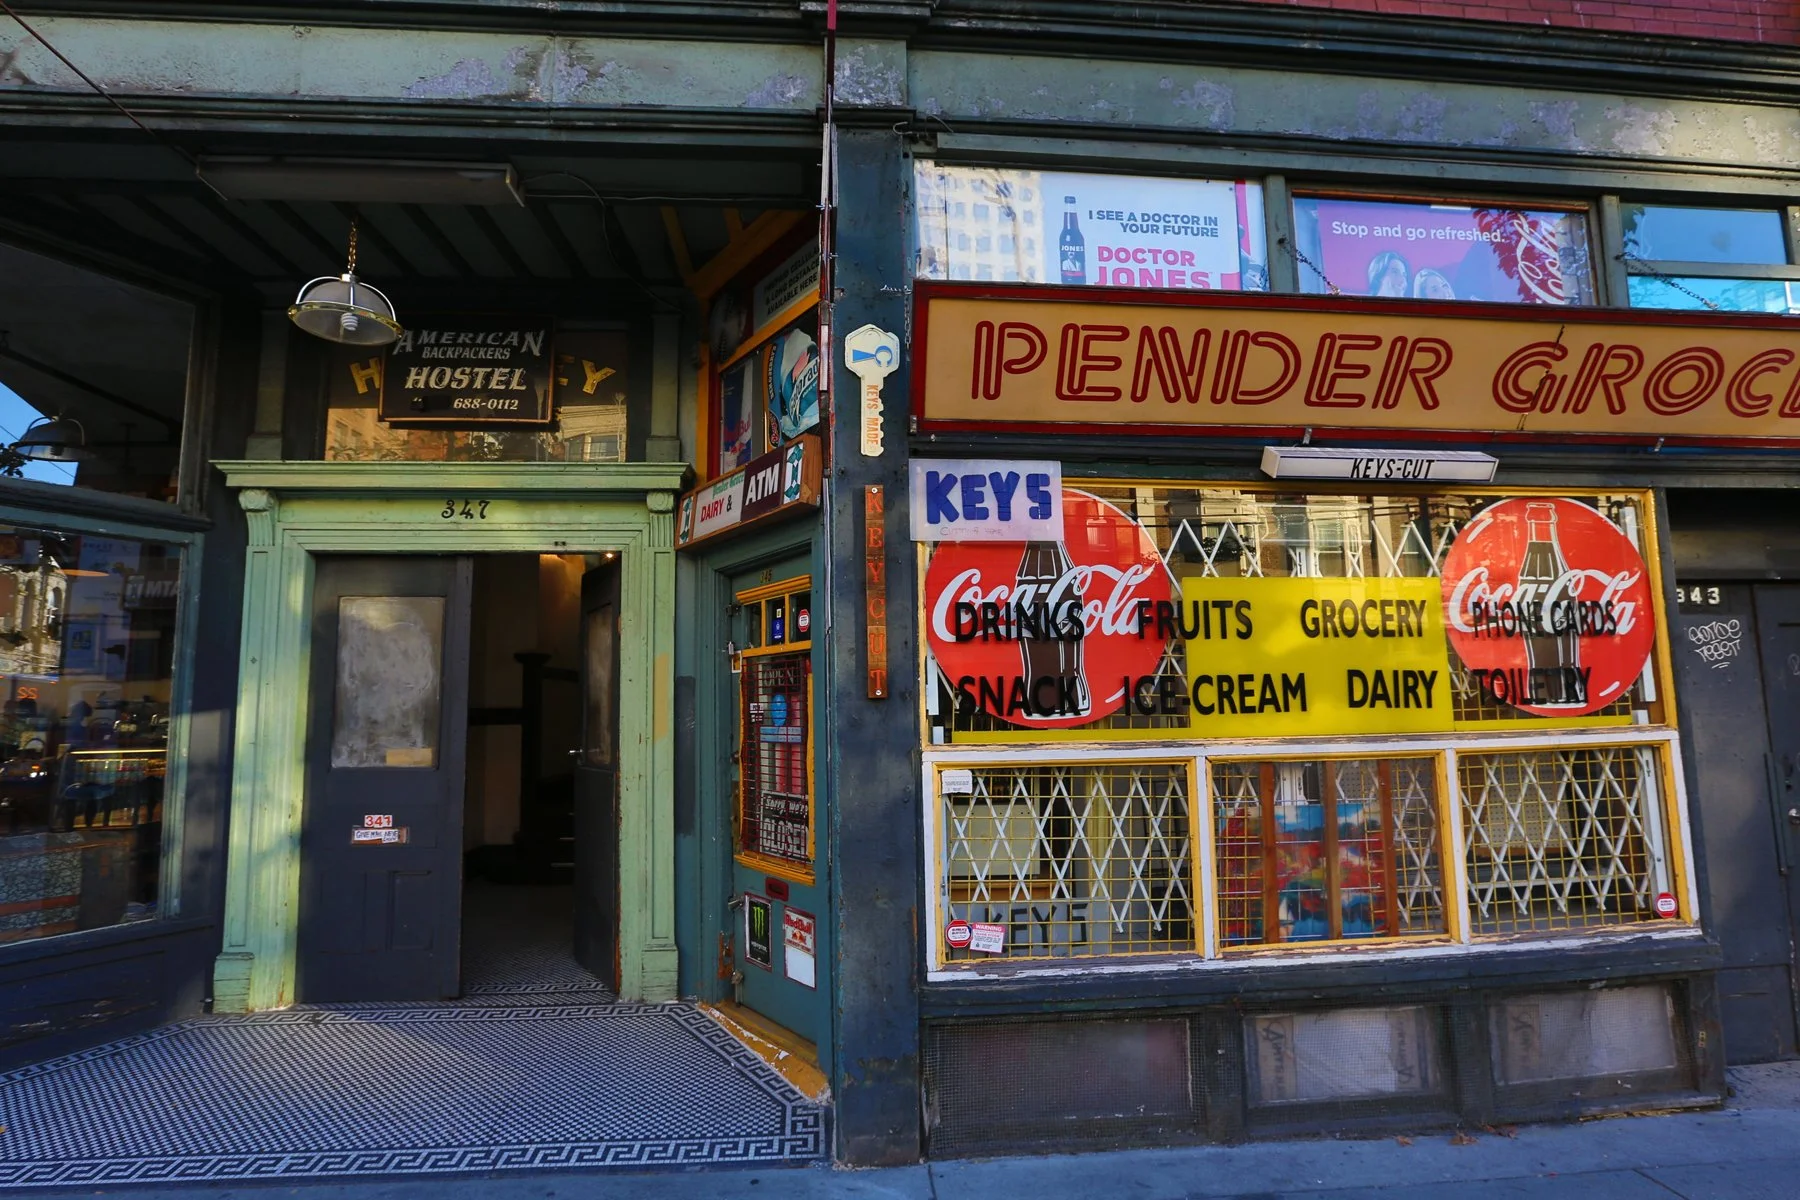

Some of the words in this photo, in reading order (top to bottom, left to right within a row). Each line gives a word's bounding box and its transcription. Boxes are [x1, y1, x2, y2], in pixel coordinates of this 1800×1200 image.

[1088, 210, 1093, 220] I
[1096, 210, 1124, 221] SEE
[1127, 212, 1138, 223] A
[1140, 213, 1201, 226] DOCTOR
[1203, 216, 1218, 227] IN
[1120, 223, 1160, 234] YOUR
[1163, 225, 1219, 238] FUTURE
[1332, 221, 1369, 238] Stop
[1373, 224, 1402, 238] and
[1406, 227, 1426, 241] go
[1430, 227, 1505, 243] refreshed.
[1097, 246, 1196, 267] DOCTOR
[800, 272, 818, 292] HERE
[1094, 266, 1211, 289] JONES
[392, 329, 545, 356] AMERICAN
[422, 346, 511, 360] BACKPACKERS
[405, 366, 527, 390] HOSTEL
[971, 320, 1454, 411] PENDER
[1491, 341, 1800, 419] GROC
[453, 397, 519, 410] 688-0112
[866, 384, 879, 410] KEYS
[866, 417, 879, 445] MADE
[1351, 457, 1435, 480] KEYS-CUT
[745, 463, 780, 506] ATM
[441, 499, 490, 520] 347
[700, 498, 725, 522] DAIRY
[726, 495, 733, 513] &
[926, 470, 1052, 525] KEYS
[866, 492, 884, 583] KEY
[932, 563, 1157, 643] Coca-Cola
[1448, 567, 1641, 636] Coca-Cola
[1676, 586, 1720, 605] 343
[954, 601, 1085, 643] DRINKS
[1136, 600, 1253, 641] FRUITS
[1300, 599, 1427, 639] GROCERY
[1472, 601, 1543, 639] PHONE
[1550, 601, 1618, 638] CARDS
[868, 598, 886, 690] CUT
[957, 675, 1084, 717] SNACK
[1347, 669, 1438, 709] DAIRY
[1472, 667, 1593, 706] TOILETRY
[365, 815, 391, 827] 347
[763, 817, 809, 859] CLOSED
[975, 923, 1002, 932] WARNING
